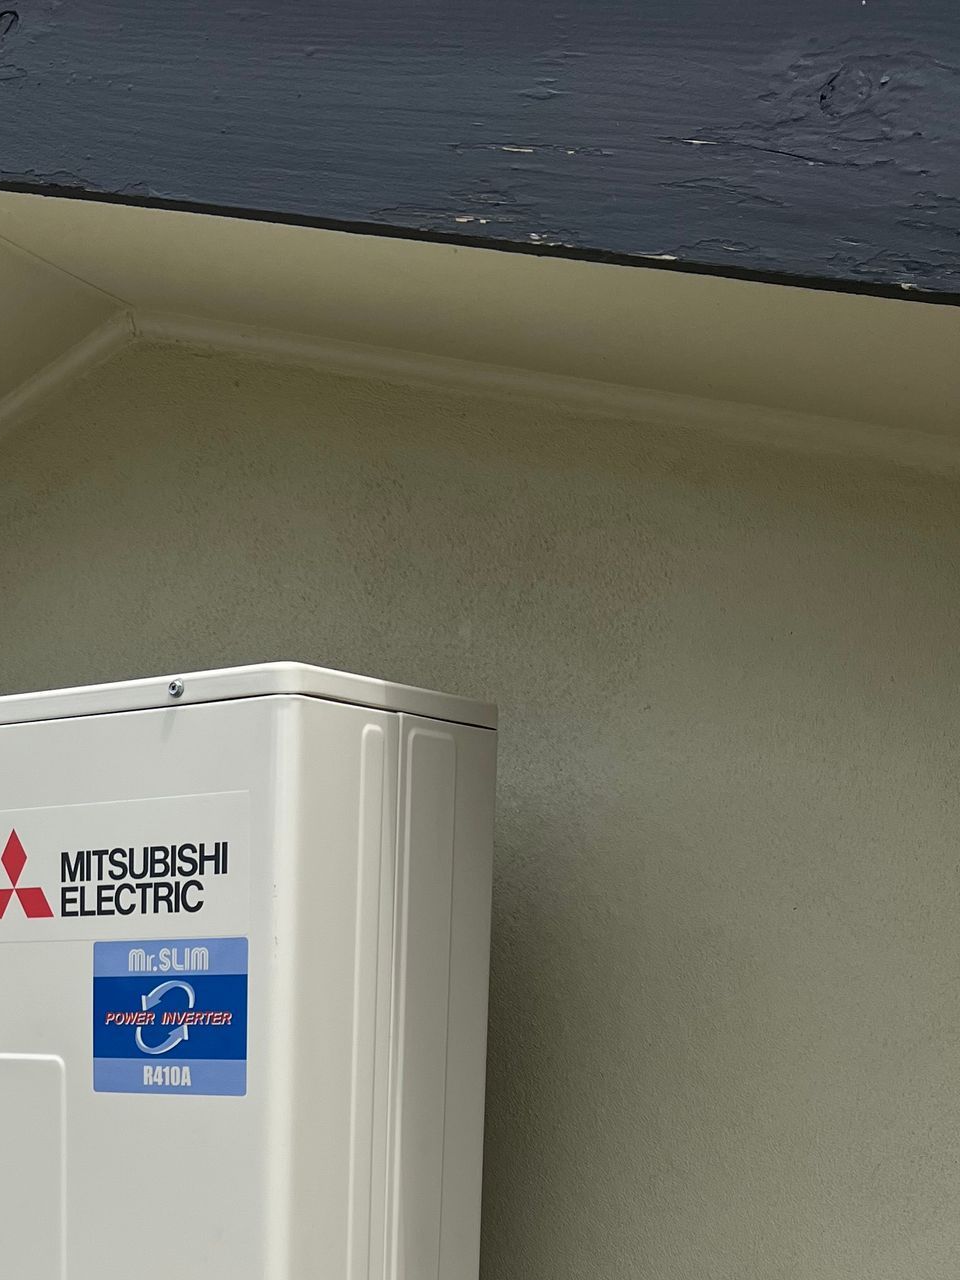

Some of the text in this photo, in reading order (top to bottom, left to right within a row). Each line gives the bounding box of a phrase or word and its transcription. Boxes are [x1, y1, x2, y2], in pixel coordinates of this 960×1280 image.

[60, 841, 228, 883] MITSUBISHI
[60, 880, 204, 917] ELECTRIC
[105, 1011, 233, 1026] POWER INVERTER
[143, 1065, 192, 1086] R410A
